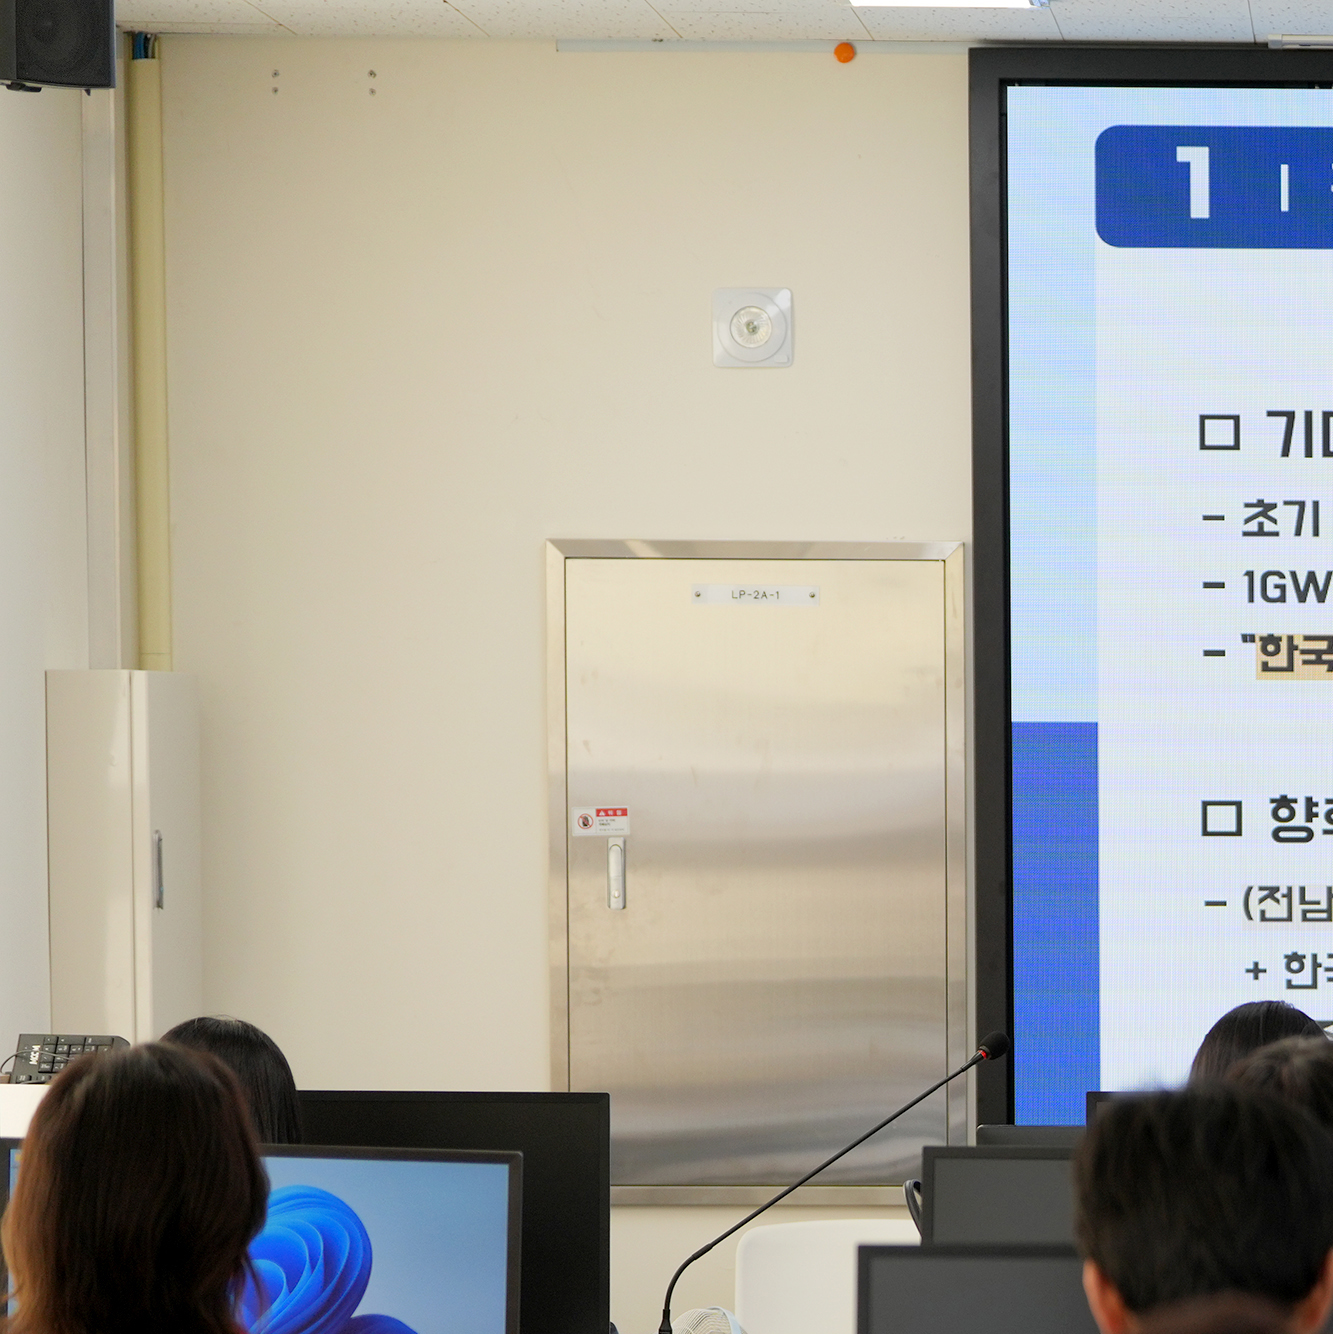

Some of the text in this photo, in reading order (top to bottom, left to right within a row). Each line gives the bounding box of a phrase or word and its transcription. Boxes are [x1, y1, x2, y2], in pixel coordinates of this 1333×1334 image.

[1177, 147, 1209, 218] 1
[1242, 499, 1319, 537] 초기
[731, 590, 780, 600] LP-2A-1
[1244, 571, 1333, 603] 1GW
